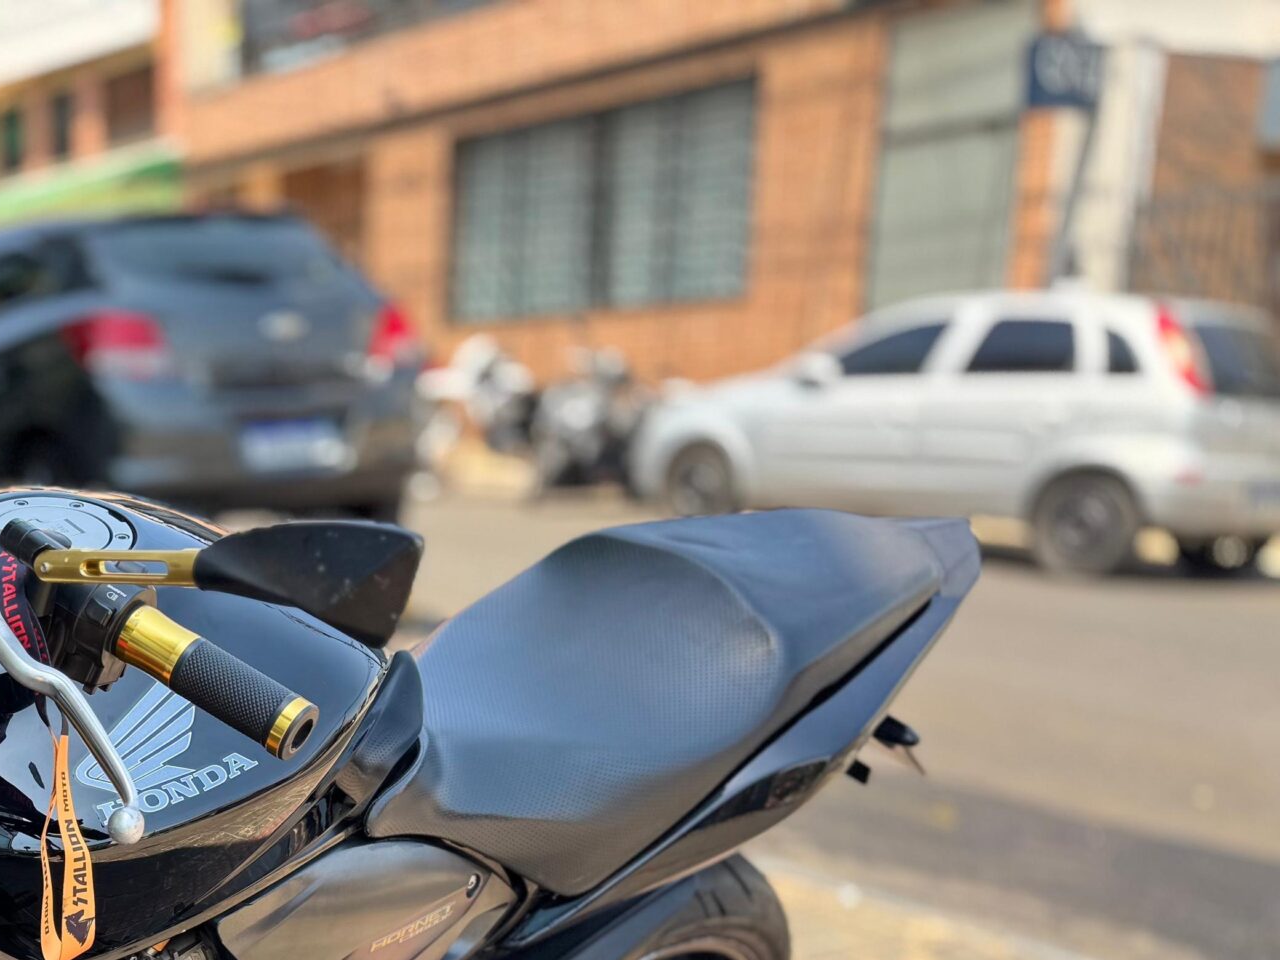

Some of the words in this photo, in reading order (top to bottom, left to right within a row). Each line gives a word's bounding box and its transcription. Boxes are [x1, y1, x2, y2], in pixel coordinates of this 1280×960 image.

[1, 563, 32, 650] STALLION
[61, 771, 70, 813] MOTO
[65, 818, 88, 907] STALLION
